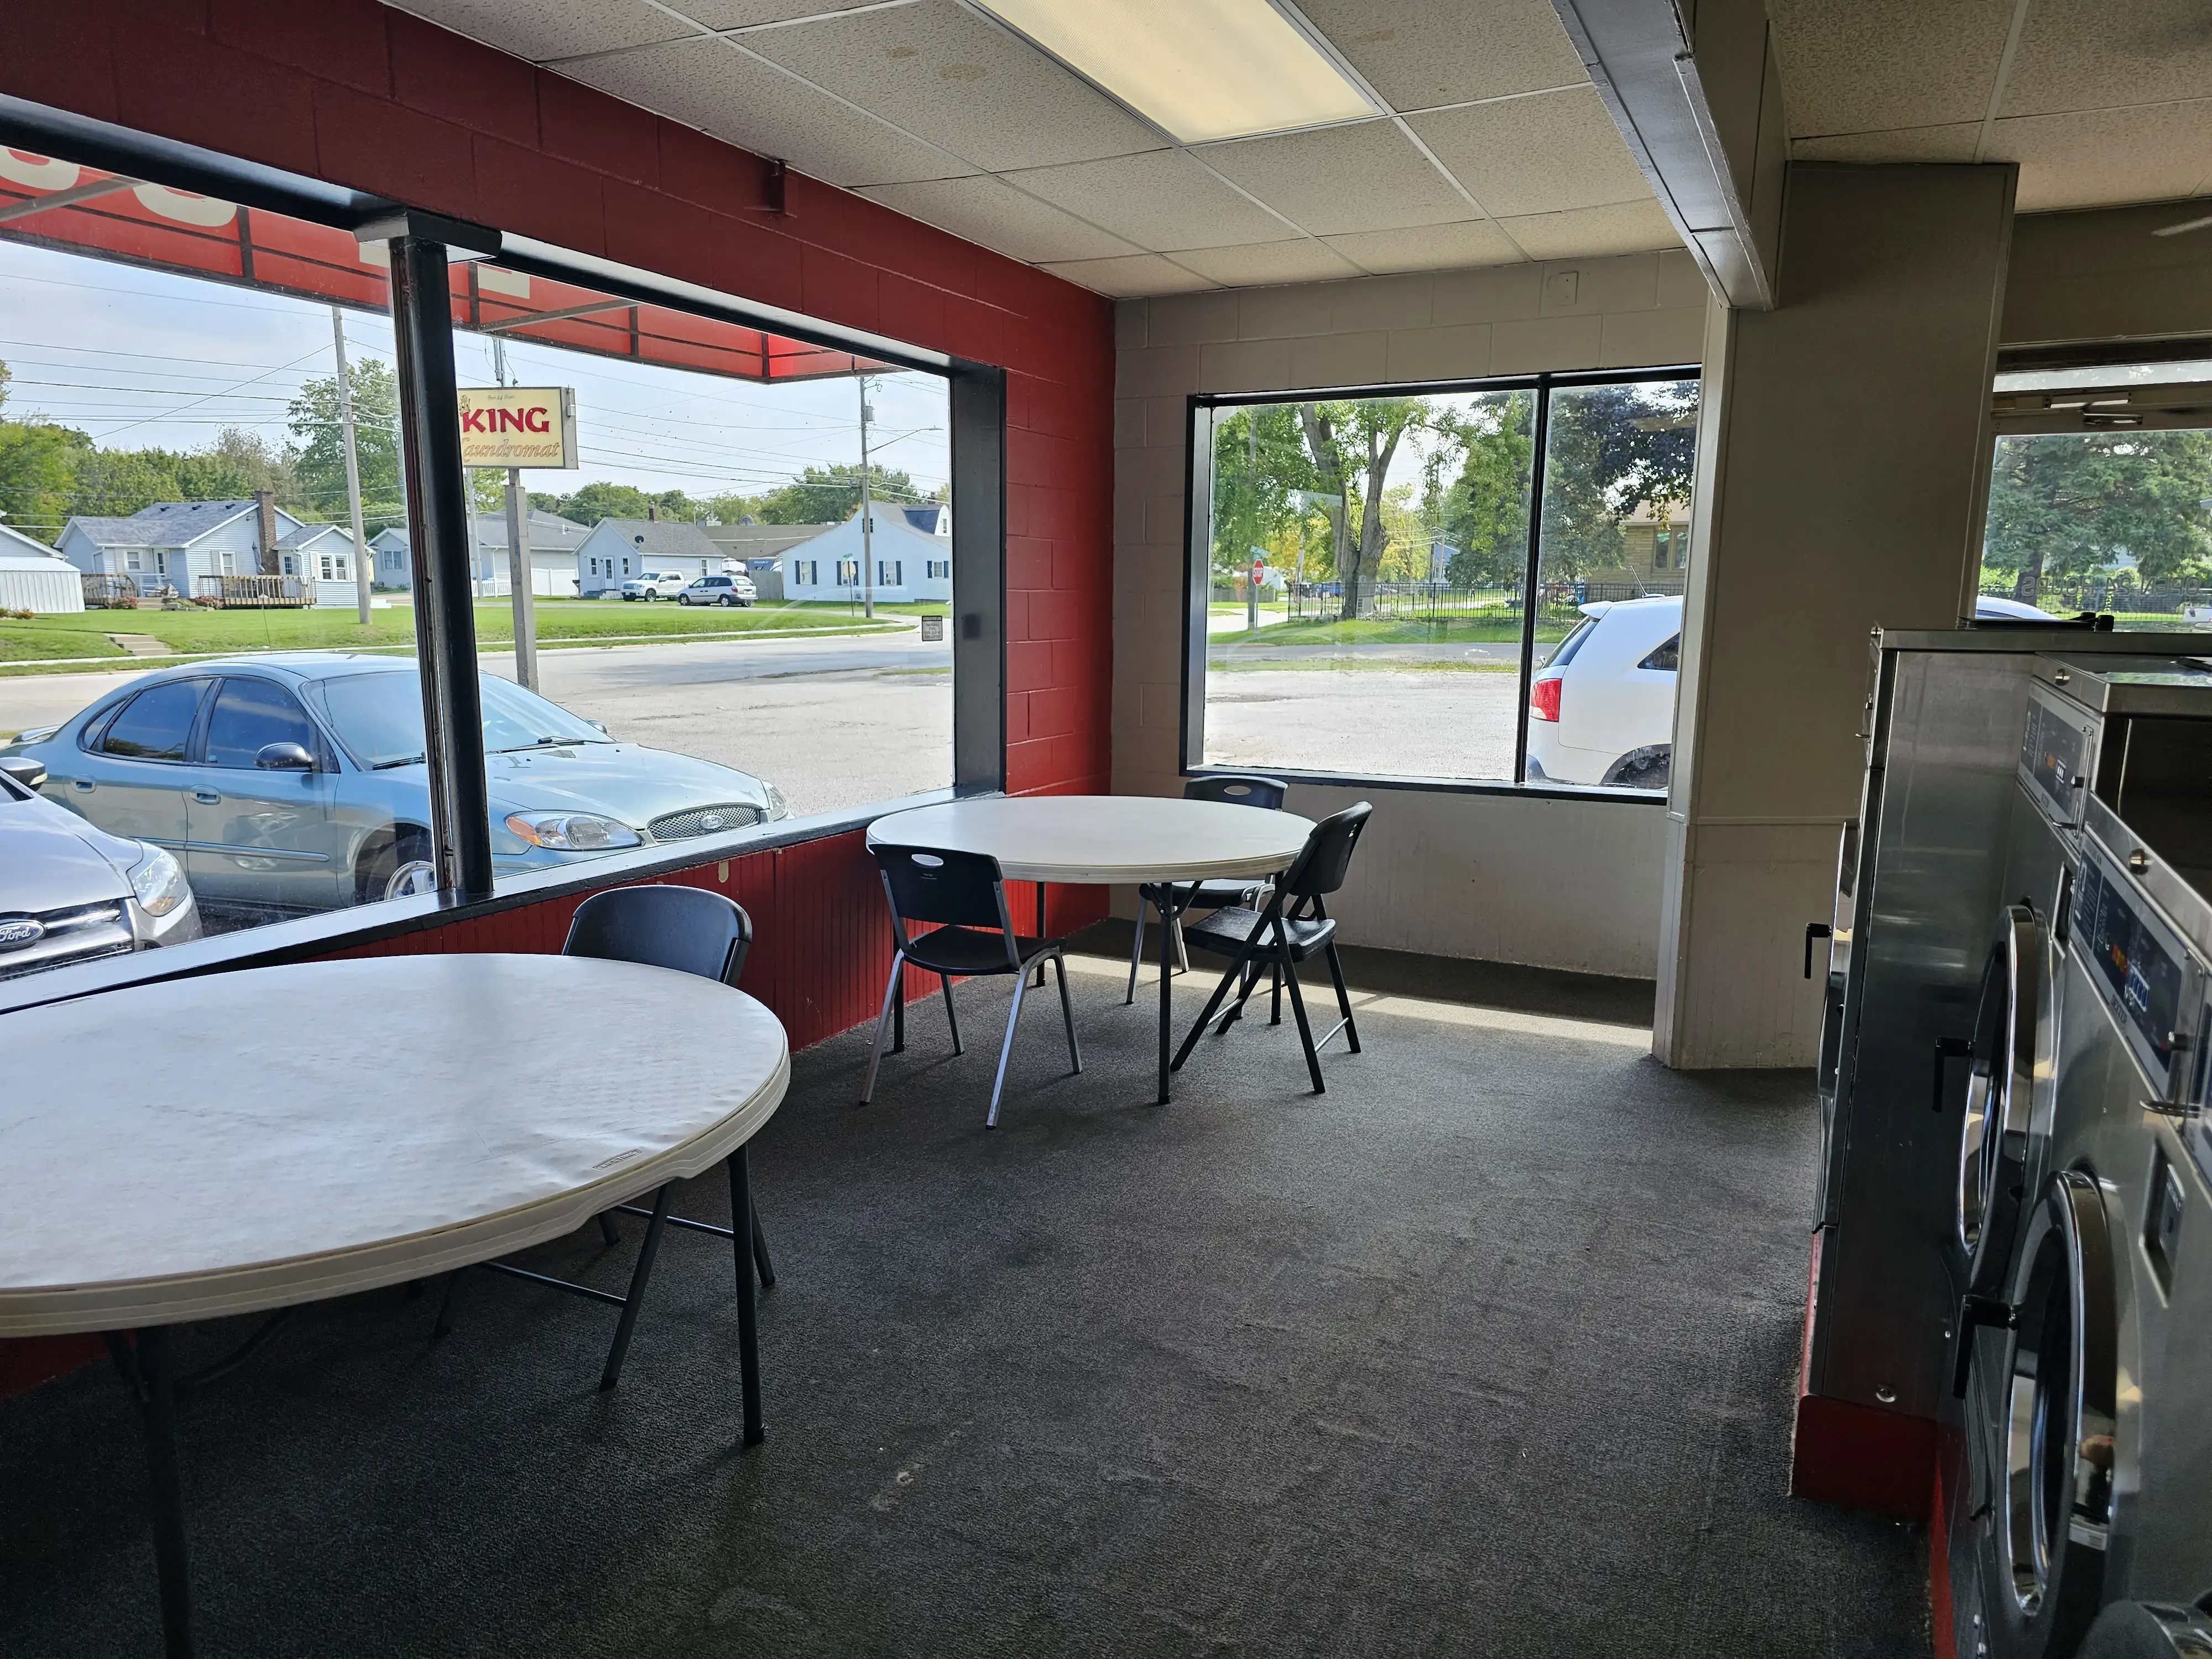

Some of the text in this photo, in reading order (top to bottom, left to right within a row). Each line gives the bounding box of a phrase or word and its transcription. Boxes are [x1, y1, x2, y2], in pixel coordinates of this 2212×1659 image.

[462, 407, 550, 433] KING
[1254, 567, 1262, 577] STOP
[0, 925, 31, 942] Ford
